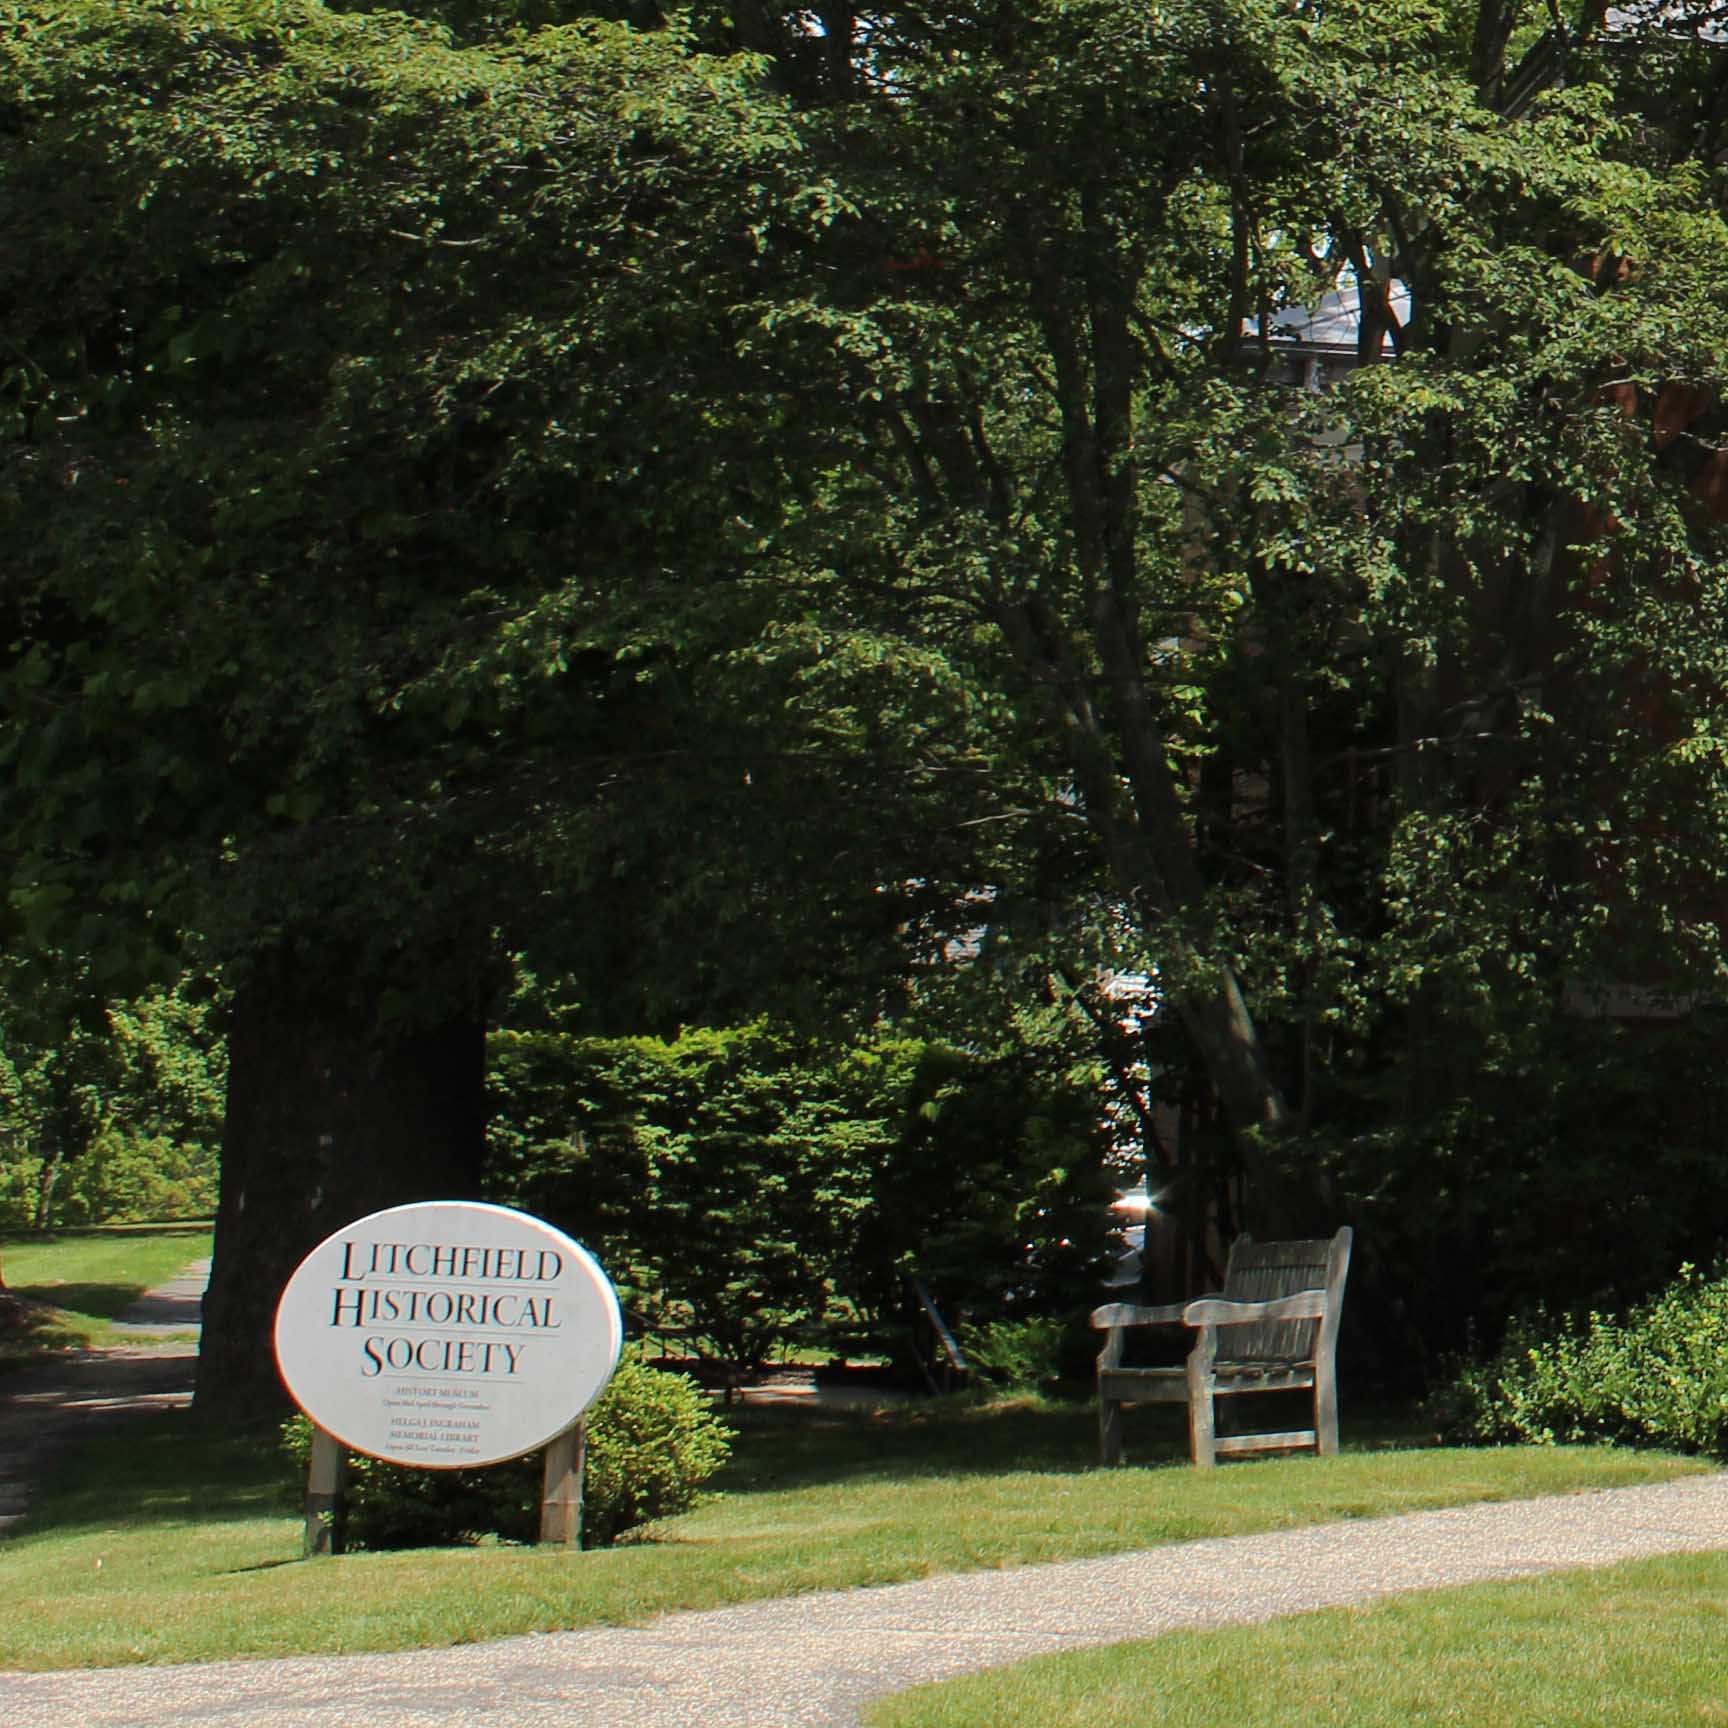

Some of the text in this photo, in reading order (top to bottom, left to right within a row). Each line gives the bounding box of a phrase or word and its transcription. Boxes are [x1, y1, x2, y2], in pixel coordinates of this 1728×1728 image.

[340, 1241, 563, 1282] LITCHFIELD
[329, 1287, 561, 1329] HISTORICAL
[361, 1336, 527, 1377] SOCIETY
